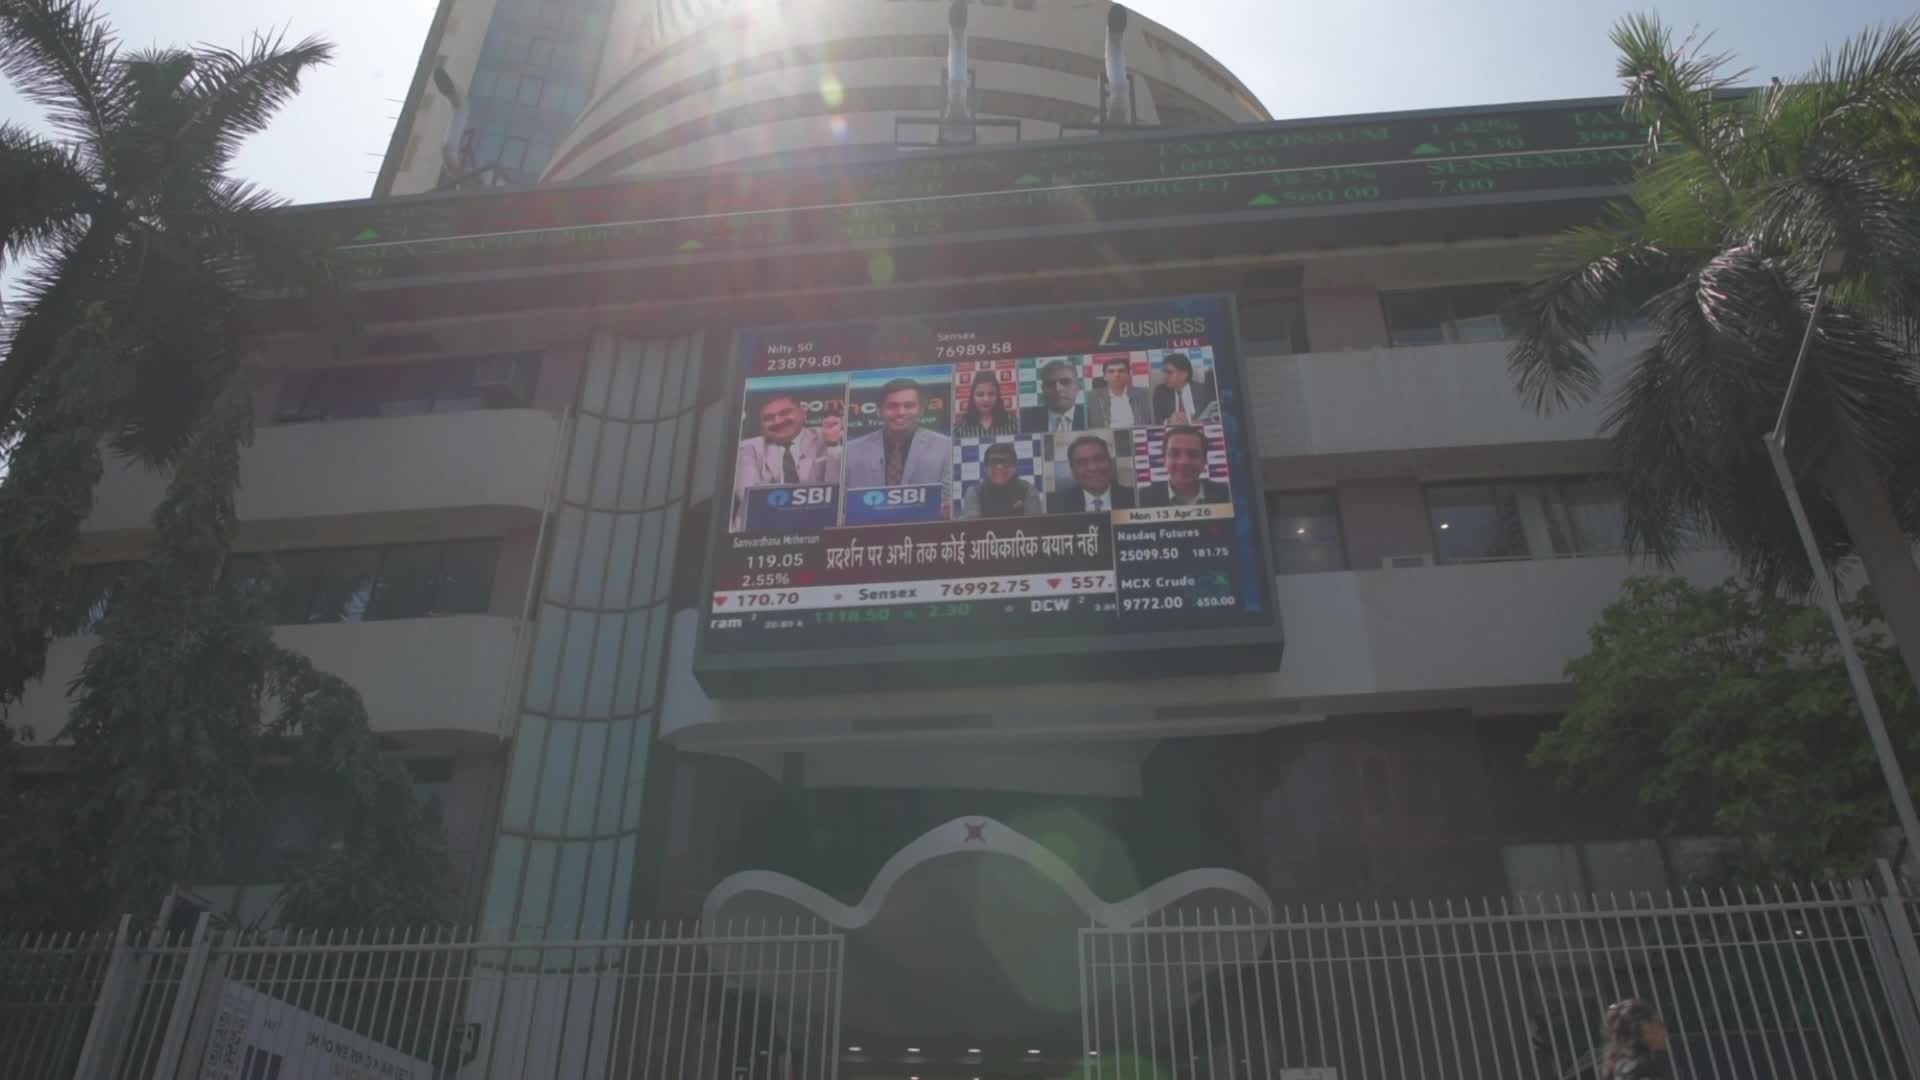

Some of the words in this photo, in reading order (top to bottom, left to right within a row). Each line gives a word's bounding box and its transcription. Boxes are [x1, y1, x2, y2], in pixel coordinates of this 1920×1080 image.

[1119, 318, 1206, 338] BUSINESS
[937, 331, 975, 342] Sensex
[1173, 338, 1199, 347] LIVE
[768, 343, 792, 355] Nifty
[797, 343, 813, 352] 50
[935, 342, 1012, 359] 76989.58
[767, 355, 842, 371] 23879.80
[792, 486, 832, 505] SBI
[888, 487, 926, 505] SBI
[1130, 511, 1151, 520] Mon
[1157, 510, 1168, 519] 13
[1118, 531, 1156, 541] Nasdaq
[1160, 528, 1199, 539] Futures
[826, 538, 863, 569] प्रदर्शन
[867, 547, 883, 566] पर
[887, 535, 912, 565] अभी
[916, 542, 937, 564] तक
[941, 532, 966, 564] कोई
[1041, 534, 1074, 556] बयान
[1076, 525, 1099, 556] नहीं
[747, 553, 803, 569] 119.05
[1120, 548, 1179, 562] 25099.50
[742, 573, 789, 587] 2.55%
[1121, 578, 1150, 589] MCX
[1156, 576, 1196, 587] Crude
[737, 592, 799, 607] 170.70
[859, 587, 918, 600] Sensex
[941, 580, 1030, 596] 76992.75
[1031, 599, 1071, 612] DCW
[1123, 597, 1183, 610] 9772.00
